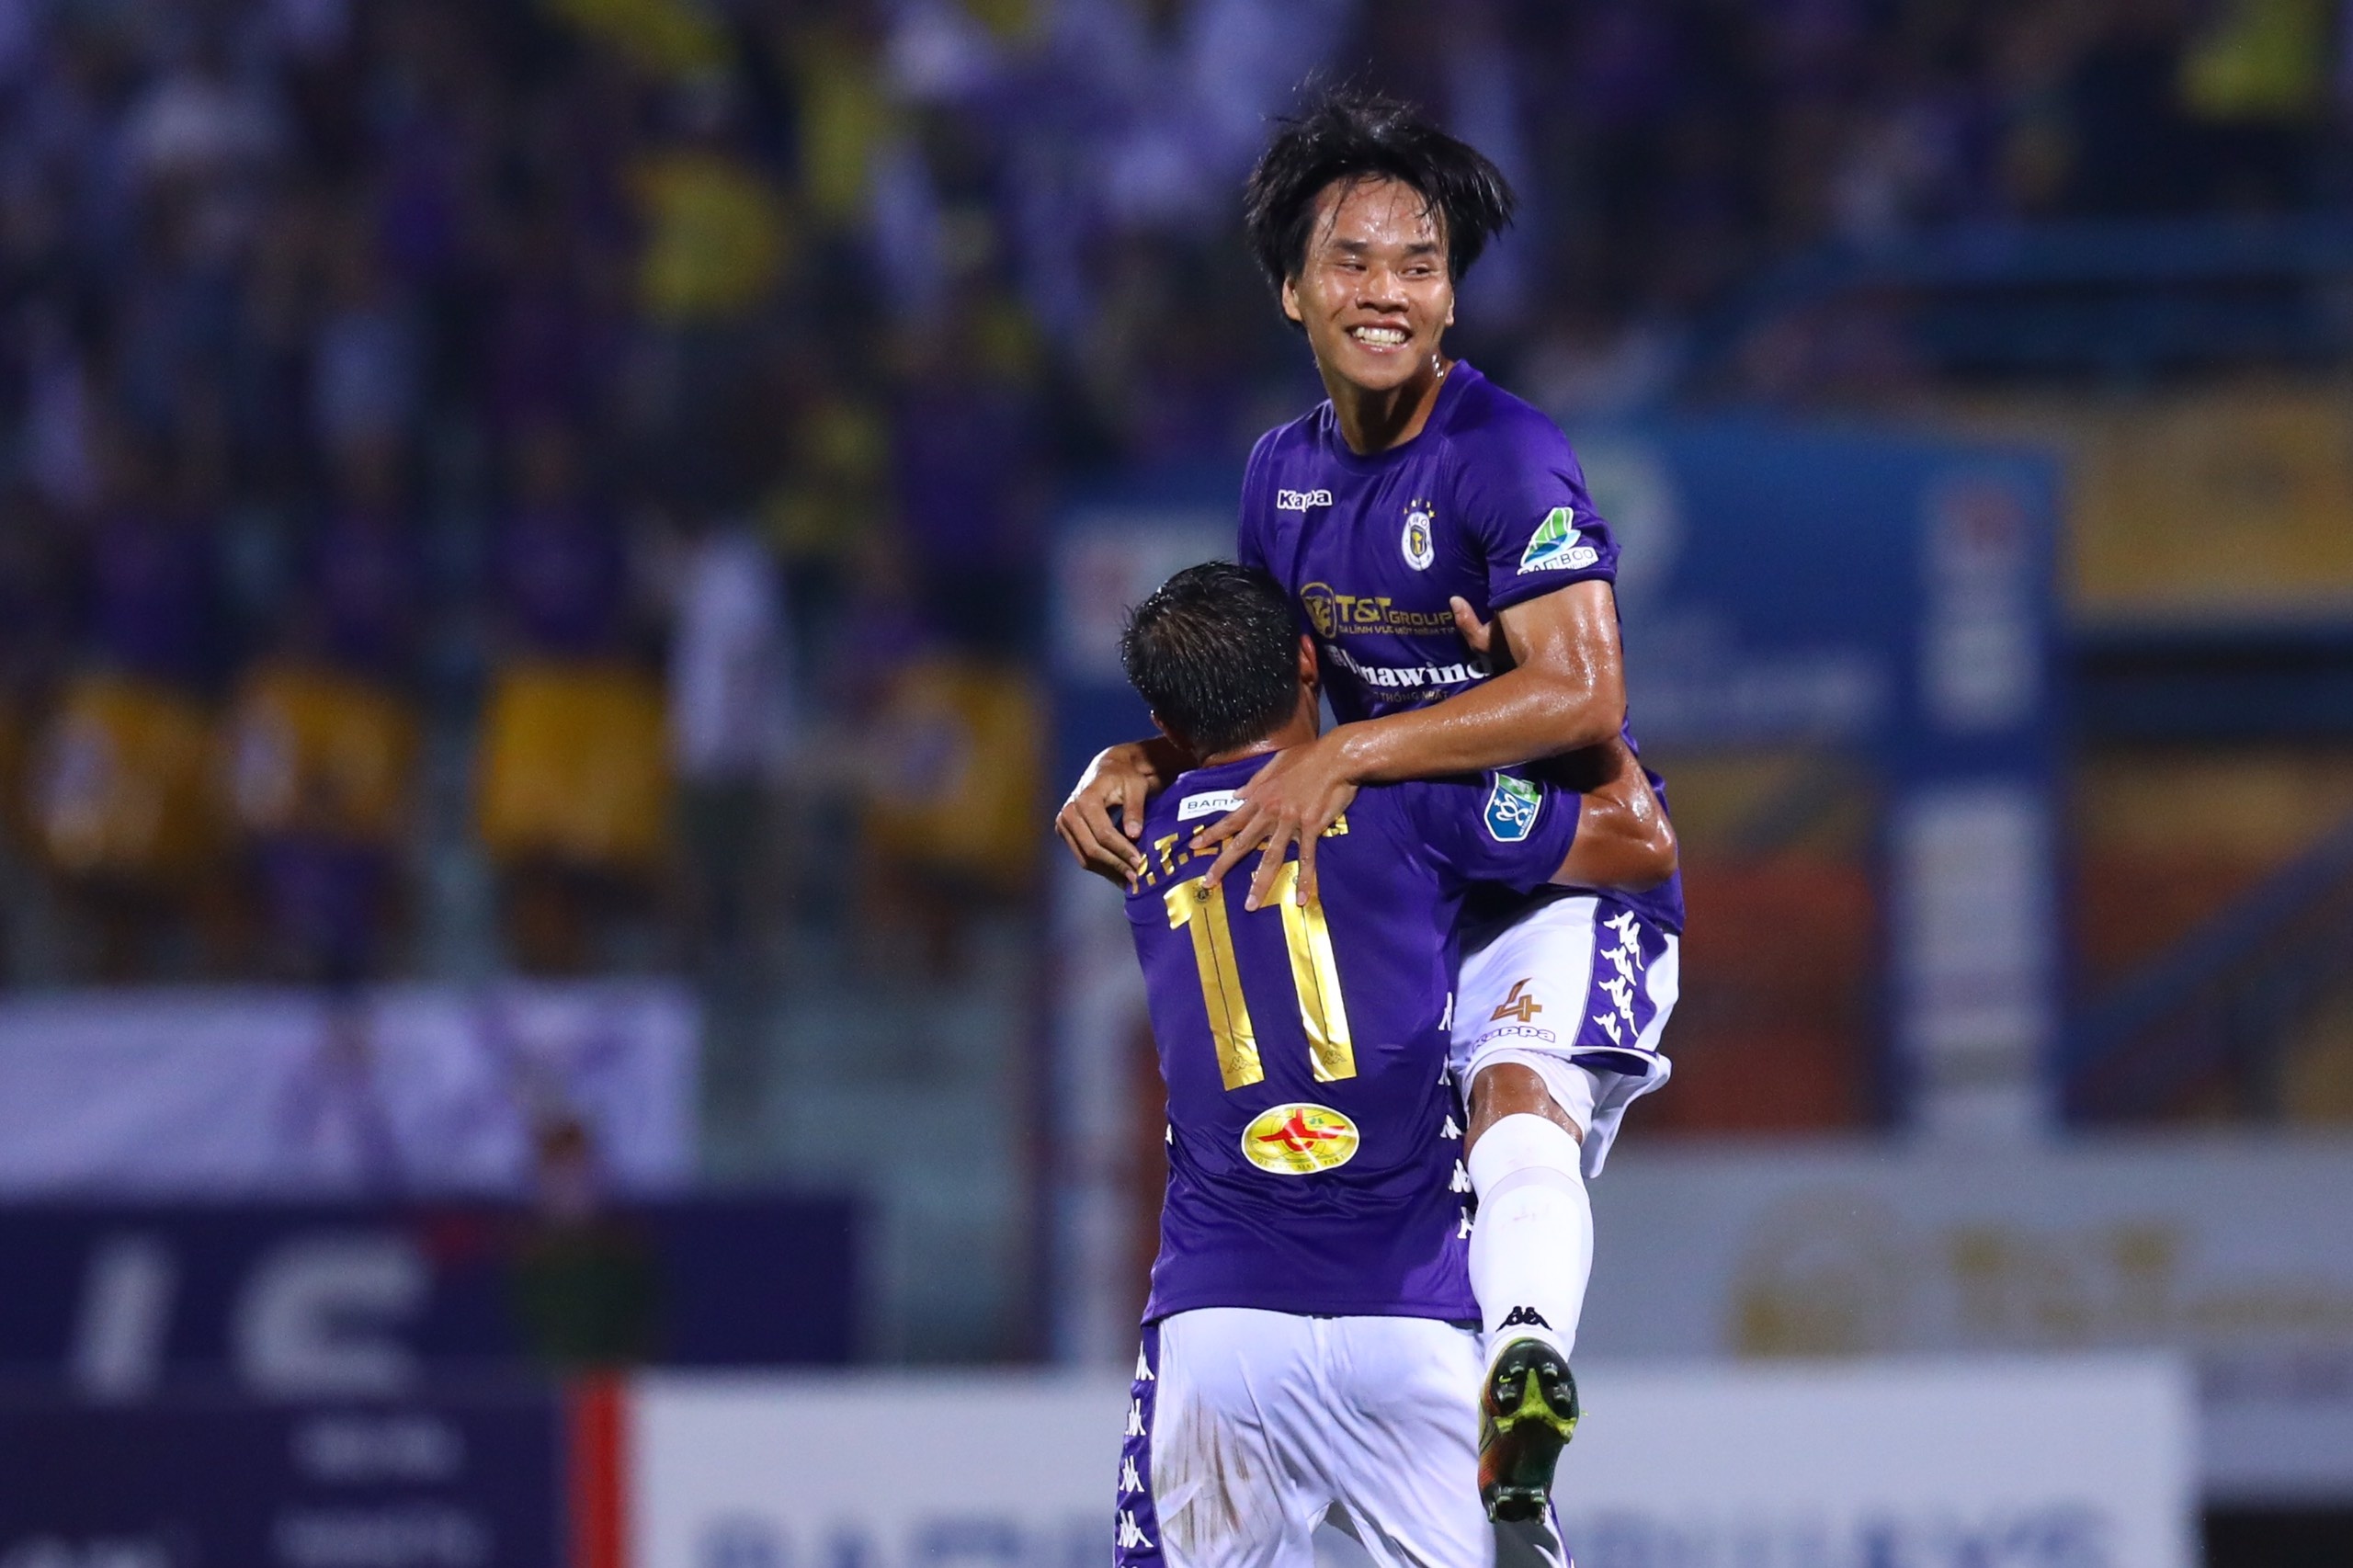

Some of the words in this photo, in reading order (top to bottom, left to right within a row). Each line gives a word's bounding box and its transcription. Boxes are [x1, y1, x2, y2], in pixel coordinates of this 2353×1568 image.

[1521, 549, 1594, 574] AMBOO
[1336, 595, 1392, 622] T&T
[1389, 610, 1454, 626] GROUP
[1164, 860, 1357, 1091] 11
[1489, 977, 1542, 1023] 4
